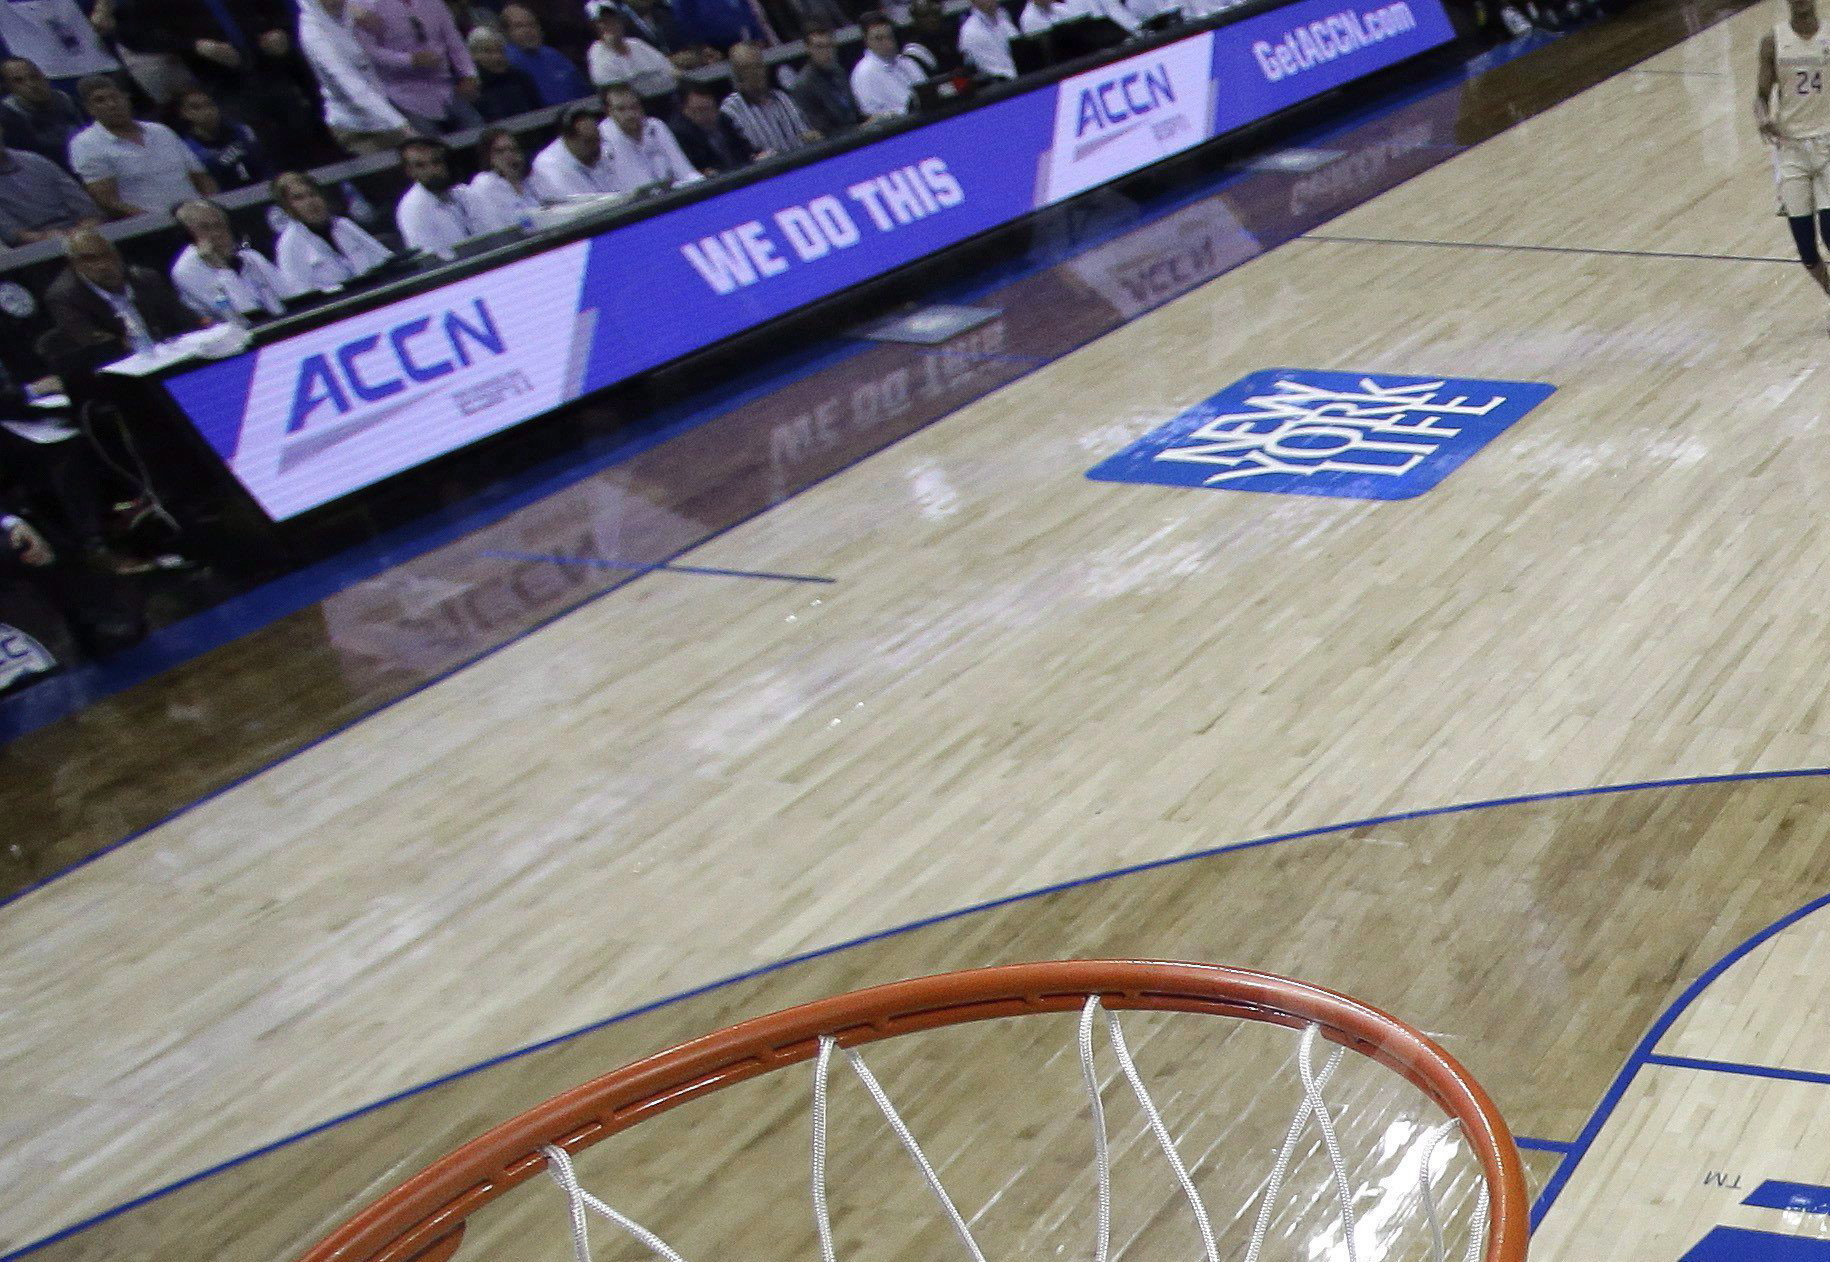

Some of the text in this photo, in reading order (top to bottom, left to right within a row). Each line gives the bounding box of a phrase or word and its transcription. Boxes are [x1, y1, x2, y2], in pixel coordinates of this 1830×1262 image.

[1252, 1, 1417, 82] GetACCN.com
[1075, 63, 1176, 138] ACCN
[1796, 70, 1822, 95] 24
[681, 156, 965, 295] WE DO THIS
[286, 297, 509, 434] ACCN
[1153, 380, 1330, 467] NEW
[1203, 378, 1446, 485] YORK
[1318, 396, 1507, 477] LIFE
[1703, 1170, 1742, 1189] TM
